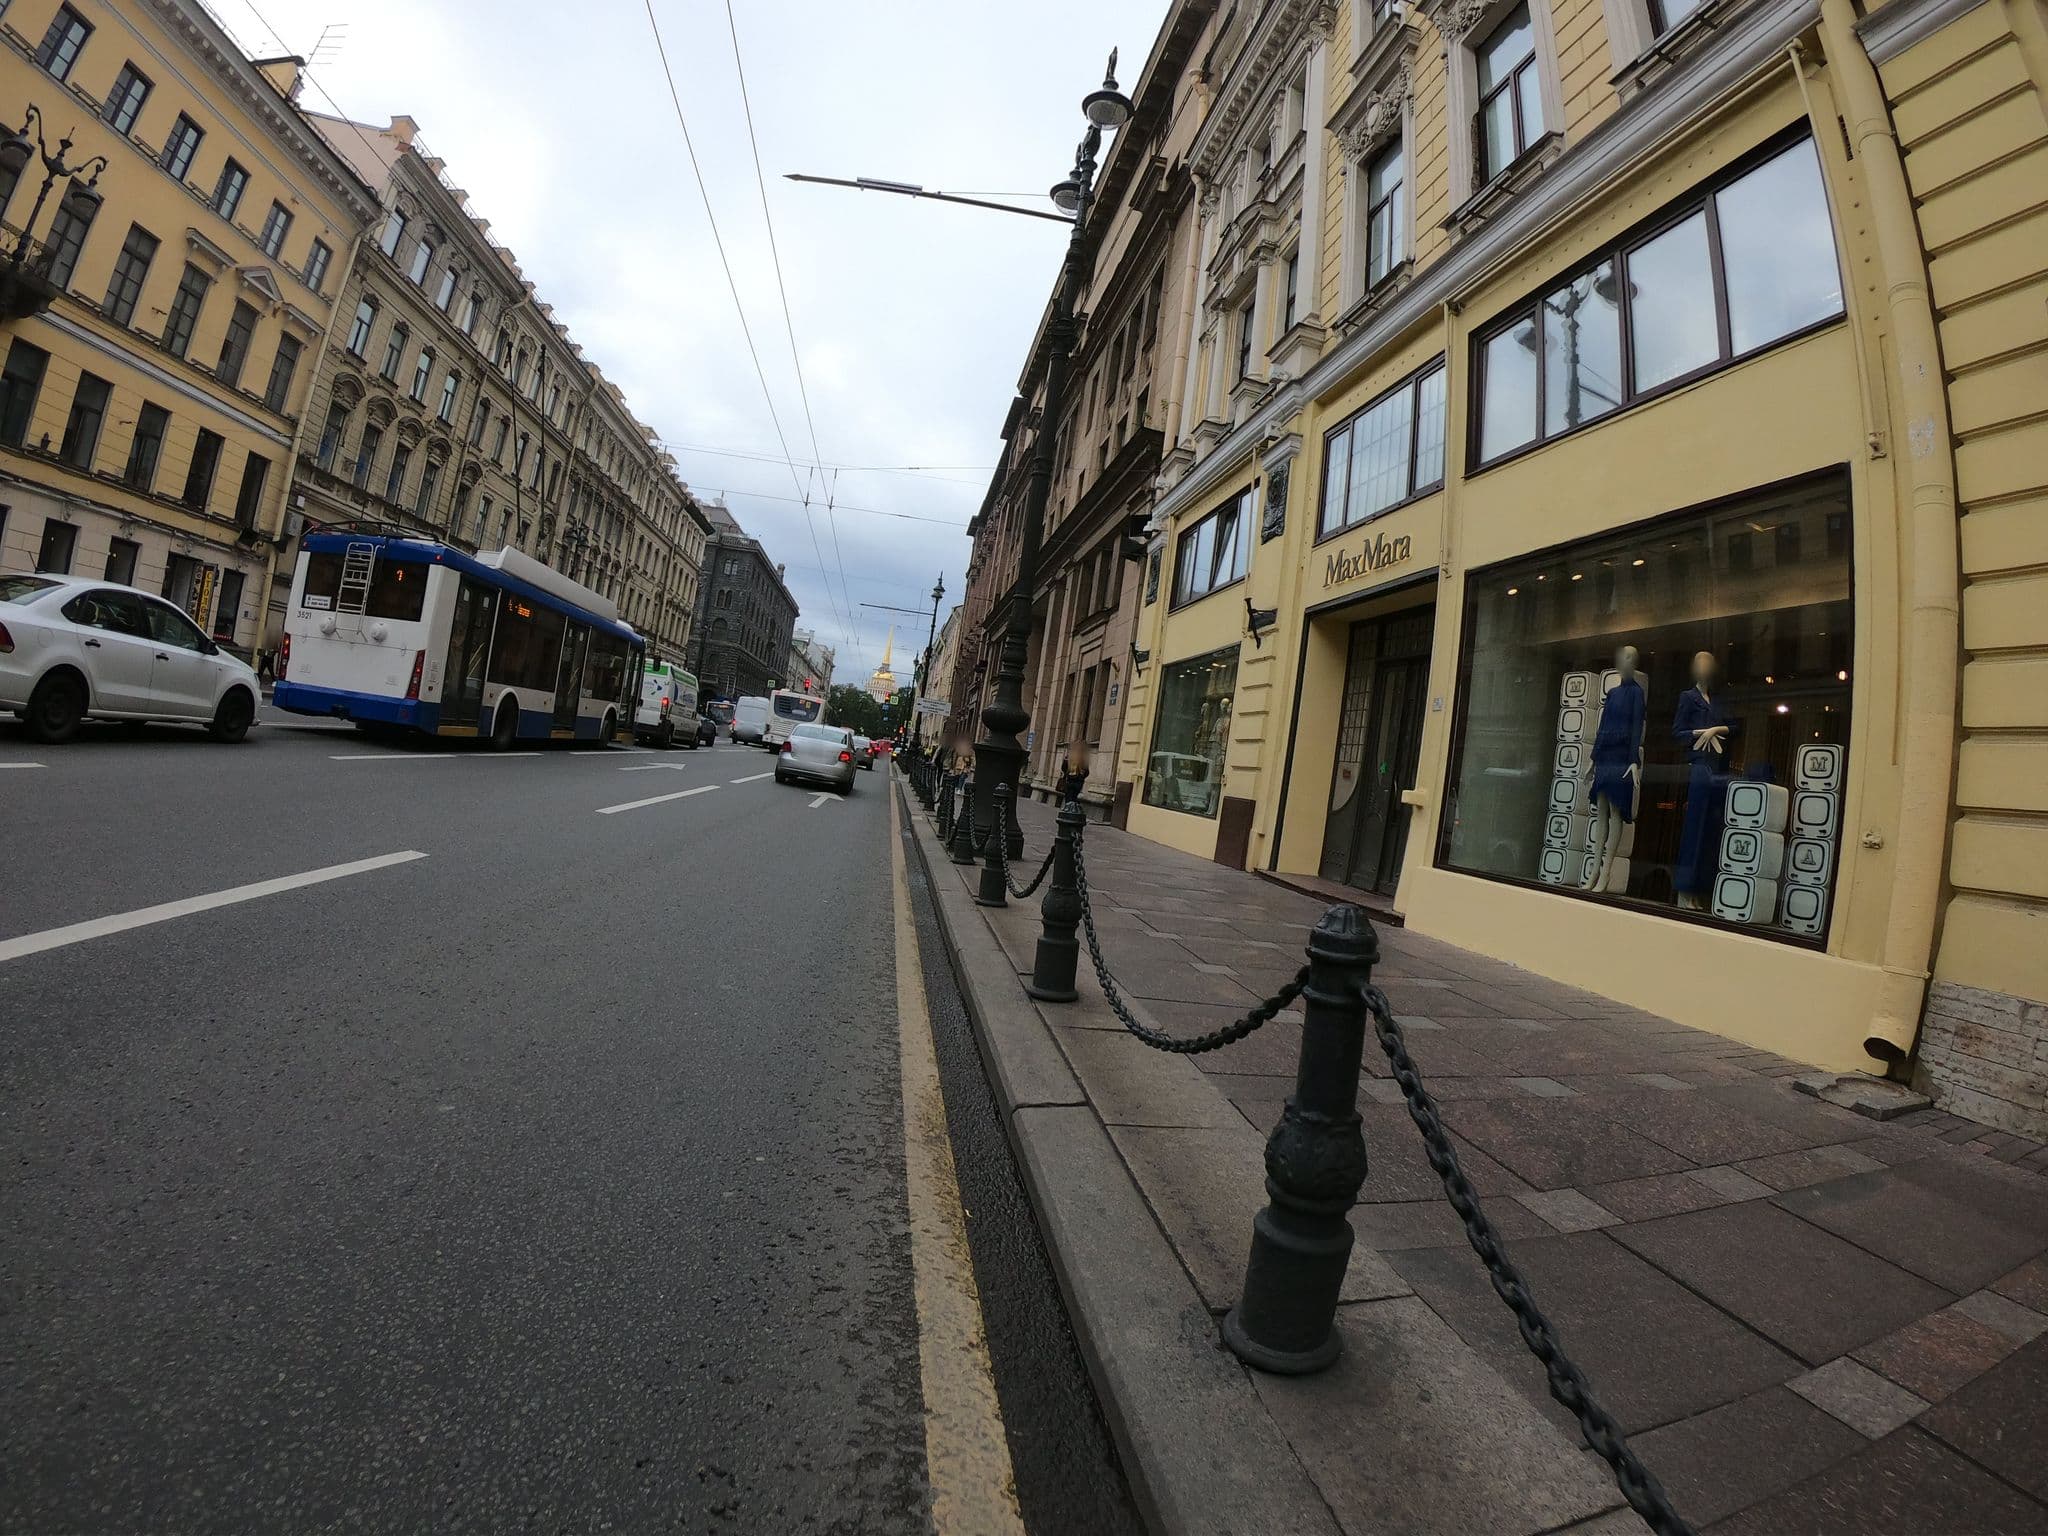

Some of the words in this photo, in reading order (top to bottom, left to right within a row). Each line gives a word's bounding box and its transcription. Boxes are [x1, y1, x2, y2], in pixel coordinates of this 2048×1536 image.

[296, 611, 312, 620] 3521
[1569, 681, 1582, 693] M
[1563, 751, 1574, 763] A
[1810, 756, 1828, 772] M
[1733, 839, 1751, 856] M
[1800, 848, 1816, 866] A
